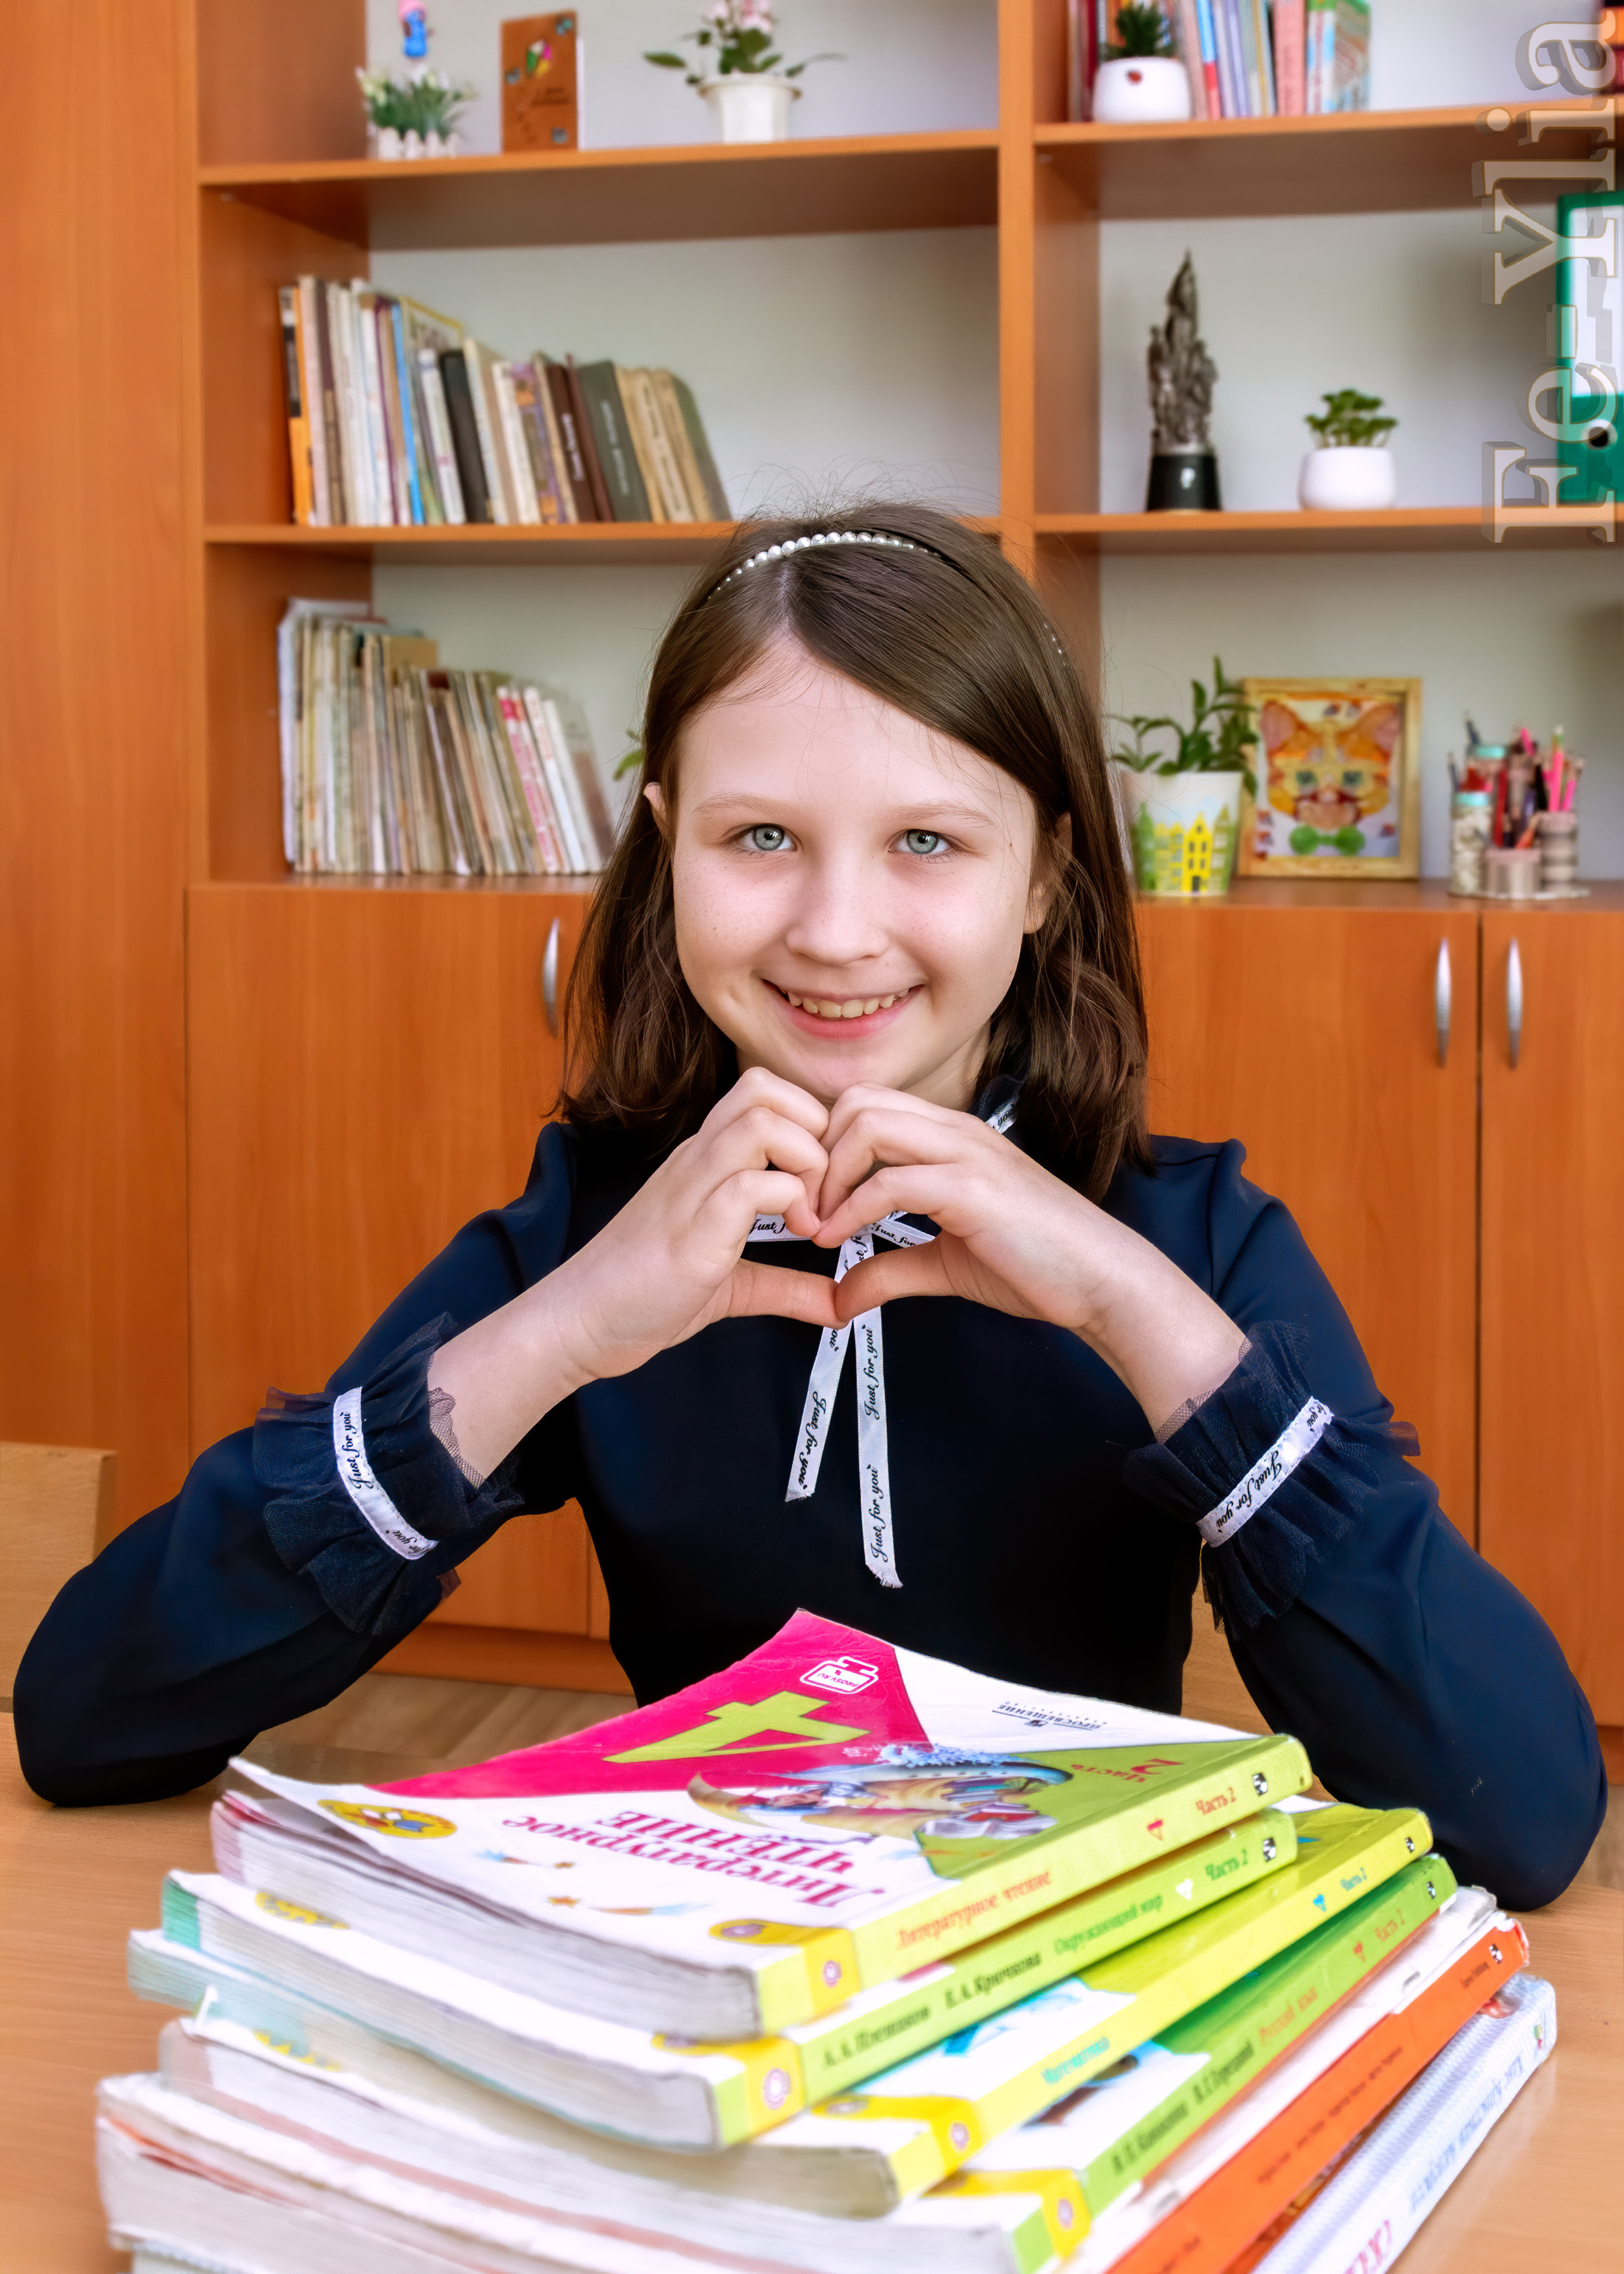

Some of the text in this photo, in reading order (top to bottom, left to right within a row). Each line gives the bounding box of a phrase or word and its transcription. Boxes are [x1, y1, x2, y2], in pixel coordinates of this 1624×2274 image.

[871, 1222, 896, 1239] Just
[829, 1329, 839, 1348] ou
[863, 1328, 880, 1421] Just for you
[798, 1391, 827, 1486] Just for you
[1306, 1407, 1319, 1428] you
[341, 1412, 374, 1490] Just for you
[868, 1466, 888, 1562] Just for you
[1216, 1450, 1282, 1529] Just for you
[816, 1673, 860, 1688] PROSV.RU
[601, 1690, 870, 1764] 4
[997, 1704, 1101, 1729] ПРОСВЕЩЕНИЕ
[1130, 1758, 1184, 1775] 2
[1195, 1786, 1237, 1816] Часть 2
[501, 1815, 886, 1908] Литературное
[596, 1810, 855, 1875] ЧТЕНИЕ
[1204, 1848, 1248, 1881] Часть 2
[897, 1871, 1052, 1950] Литературное чтение
